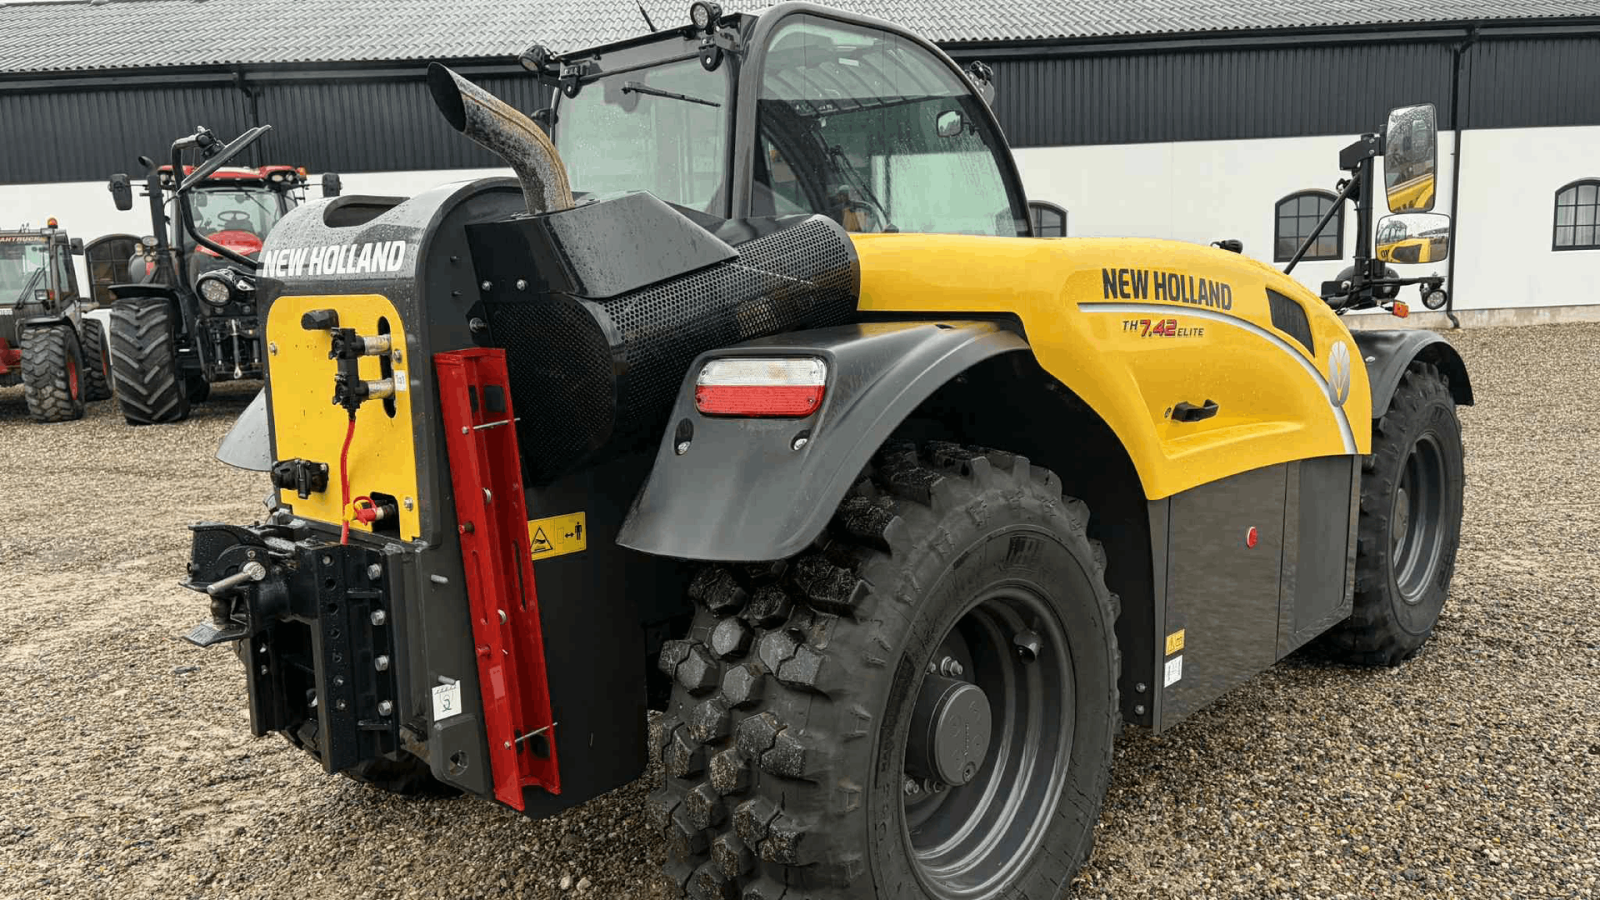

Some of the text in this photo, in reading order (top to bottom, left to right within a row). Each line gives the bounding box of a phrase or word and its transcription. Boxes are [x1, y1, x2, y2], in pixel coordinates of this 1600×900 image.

[262, 240, 406, 278] NEW HOLLAND
[1102, 268, 1232, 311] NEW HOLLAND
[1177, 327, 1205, 338] ELITE
